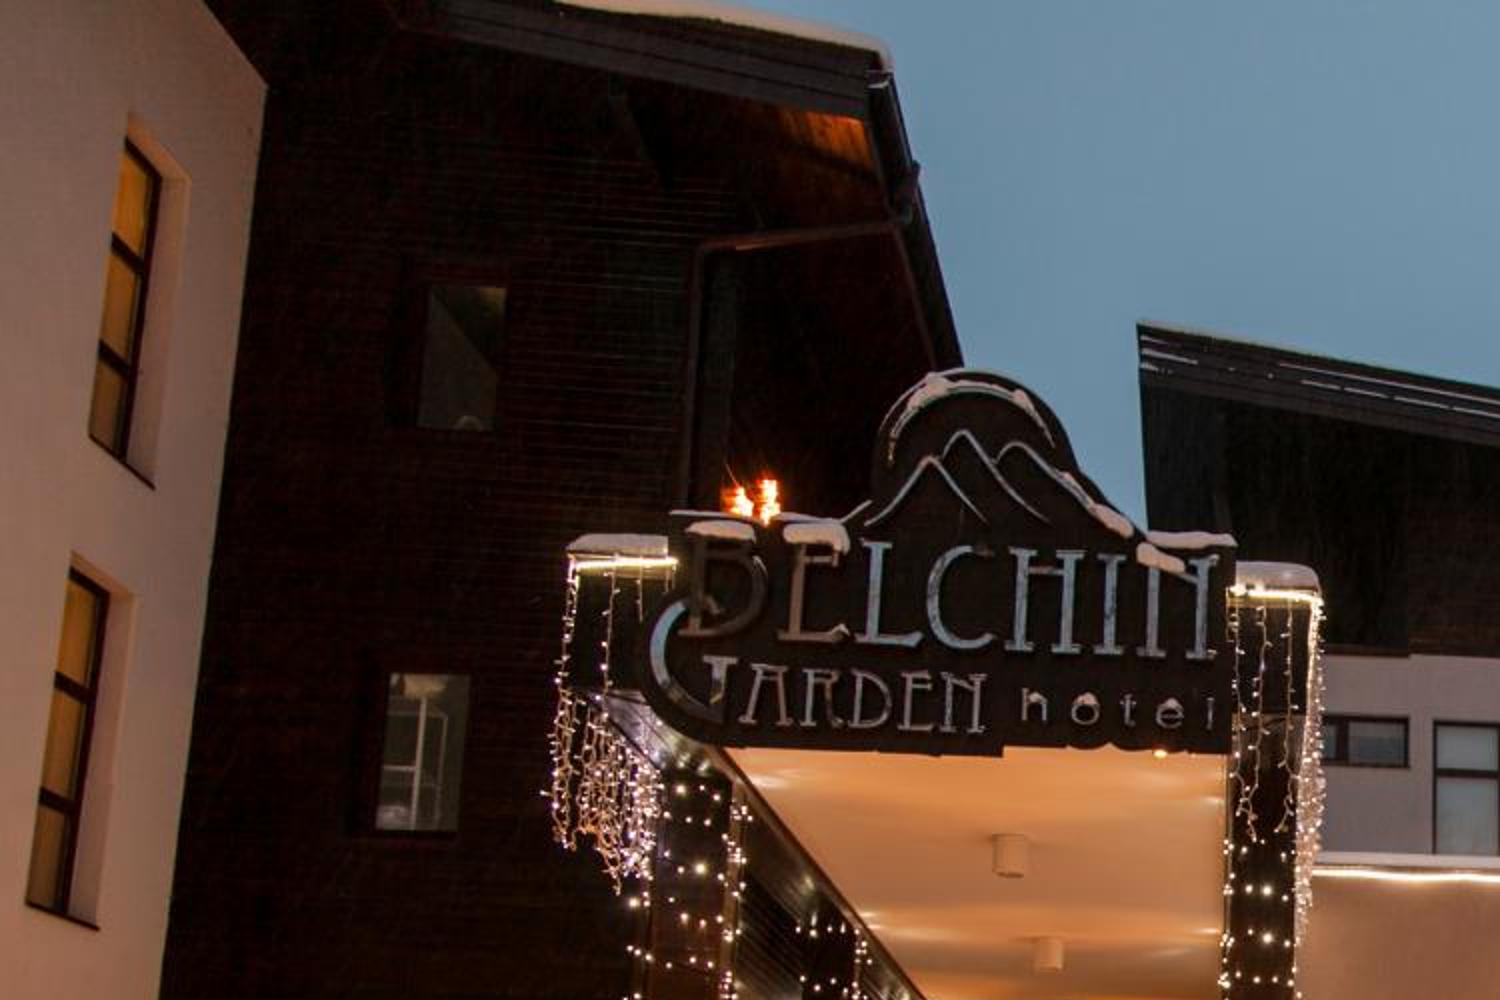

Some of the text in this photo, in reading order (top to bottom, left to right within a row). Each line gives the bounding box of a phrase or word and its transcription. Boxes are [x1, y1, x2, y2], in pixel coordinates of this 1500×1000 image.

[676, 534, 1220, 660] BELCHIN
[651, 601, 1216, 734] GARDEN hotel
